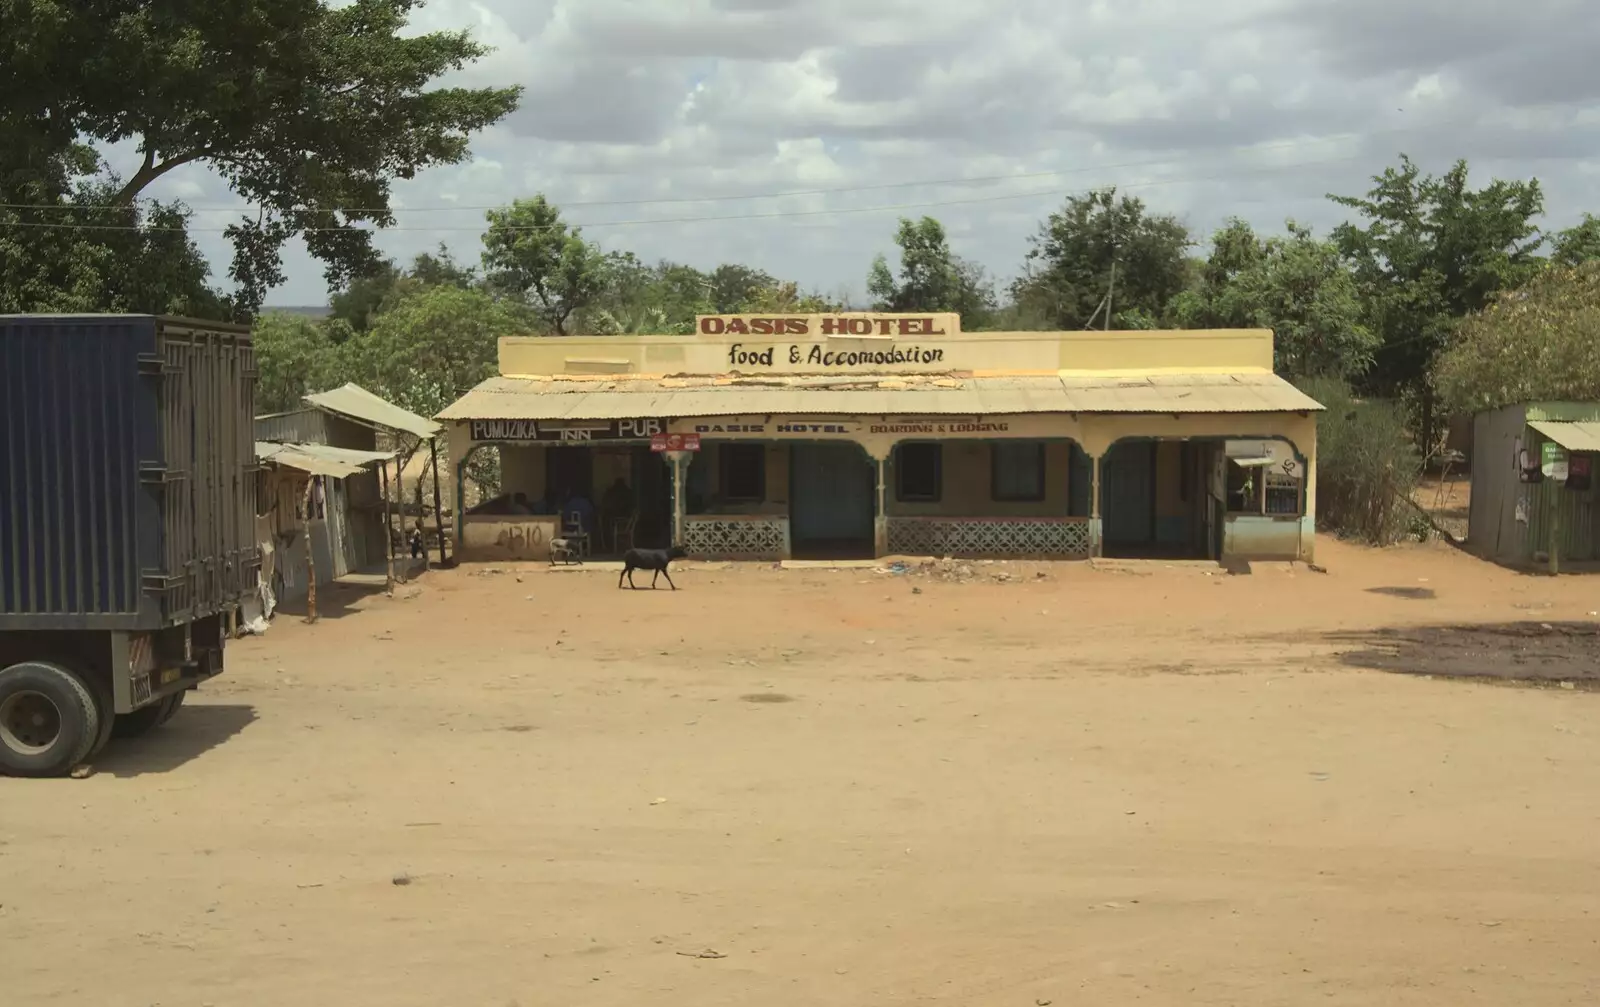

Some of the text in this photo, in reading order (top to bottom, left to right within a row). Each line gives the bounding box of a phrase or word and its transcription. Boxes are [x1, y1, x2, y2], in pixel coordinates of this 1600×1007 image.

[701, 317, 945, 335] OASIS HOTEL
[729, 343, 944, 367] food & Accomodation
[473, 420, 538, 440] PUMUZIKA
[560, 429, 592, 440] INN
[618, 419, 662, 437] PUB
[695, 424, 765, 433] OASIS
[777, 424, 850, 434] HOTEL
[870, 424, 933, 434] BOARDING
[937, 424, 946, 433] &
[949, 422, 1008, 432] LODGING
